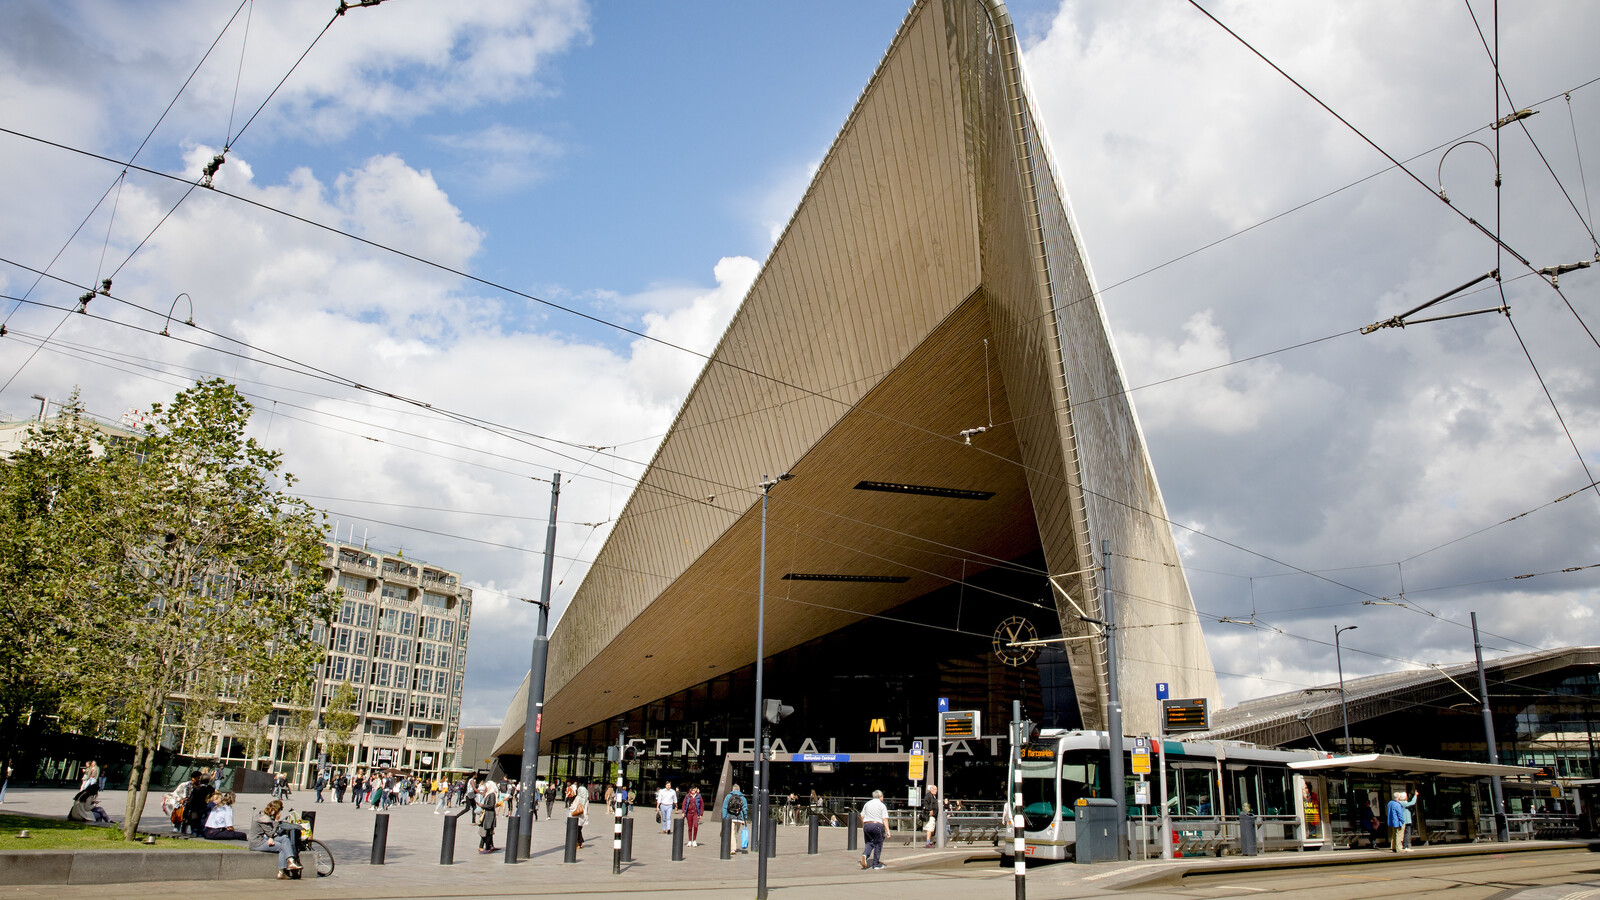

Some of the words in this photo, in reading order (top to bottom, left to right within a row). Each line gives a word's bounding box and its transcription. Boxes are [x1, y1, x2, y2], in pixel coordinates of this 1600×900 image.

[1159, 684, 1165, 692] B
[940, 698, 946, 706] A
[870, 719, 886, 732] M
[1025, 846, 1037, 855] ET
